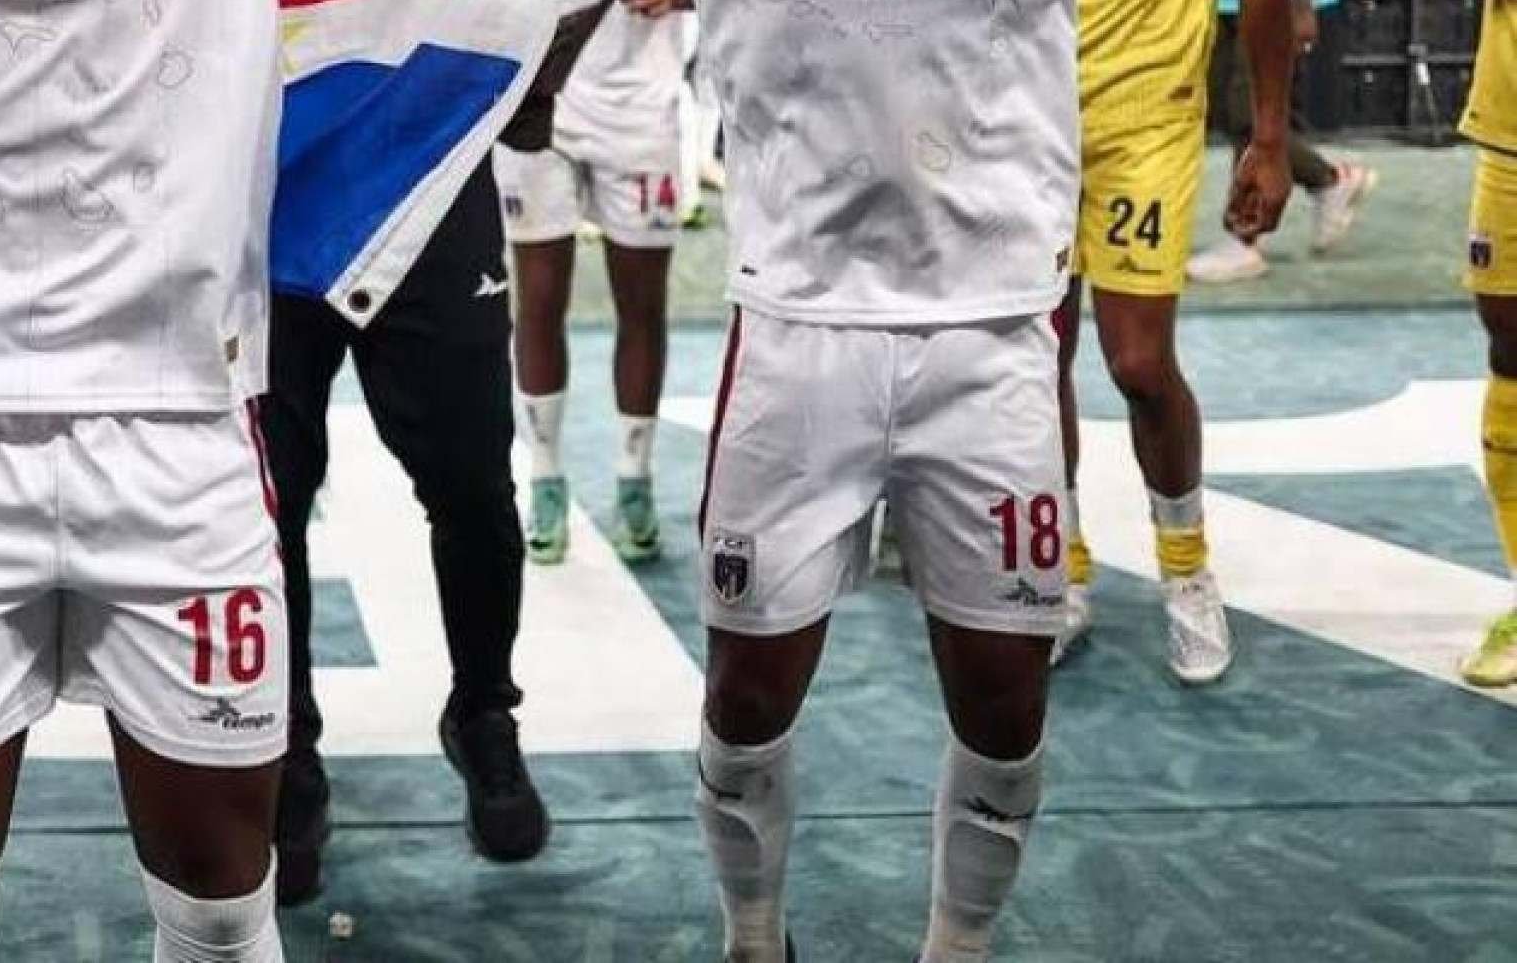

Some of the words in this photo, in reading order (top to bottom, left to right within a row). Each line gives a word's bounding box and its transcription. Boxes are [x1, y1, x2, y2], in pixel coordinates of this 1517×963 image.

[1107, 197, 1162, 249] 24
[990, 493, 1060, 571] 18
[178, 588, 266, 684] 16
